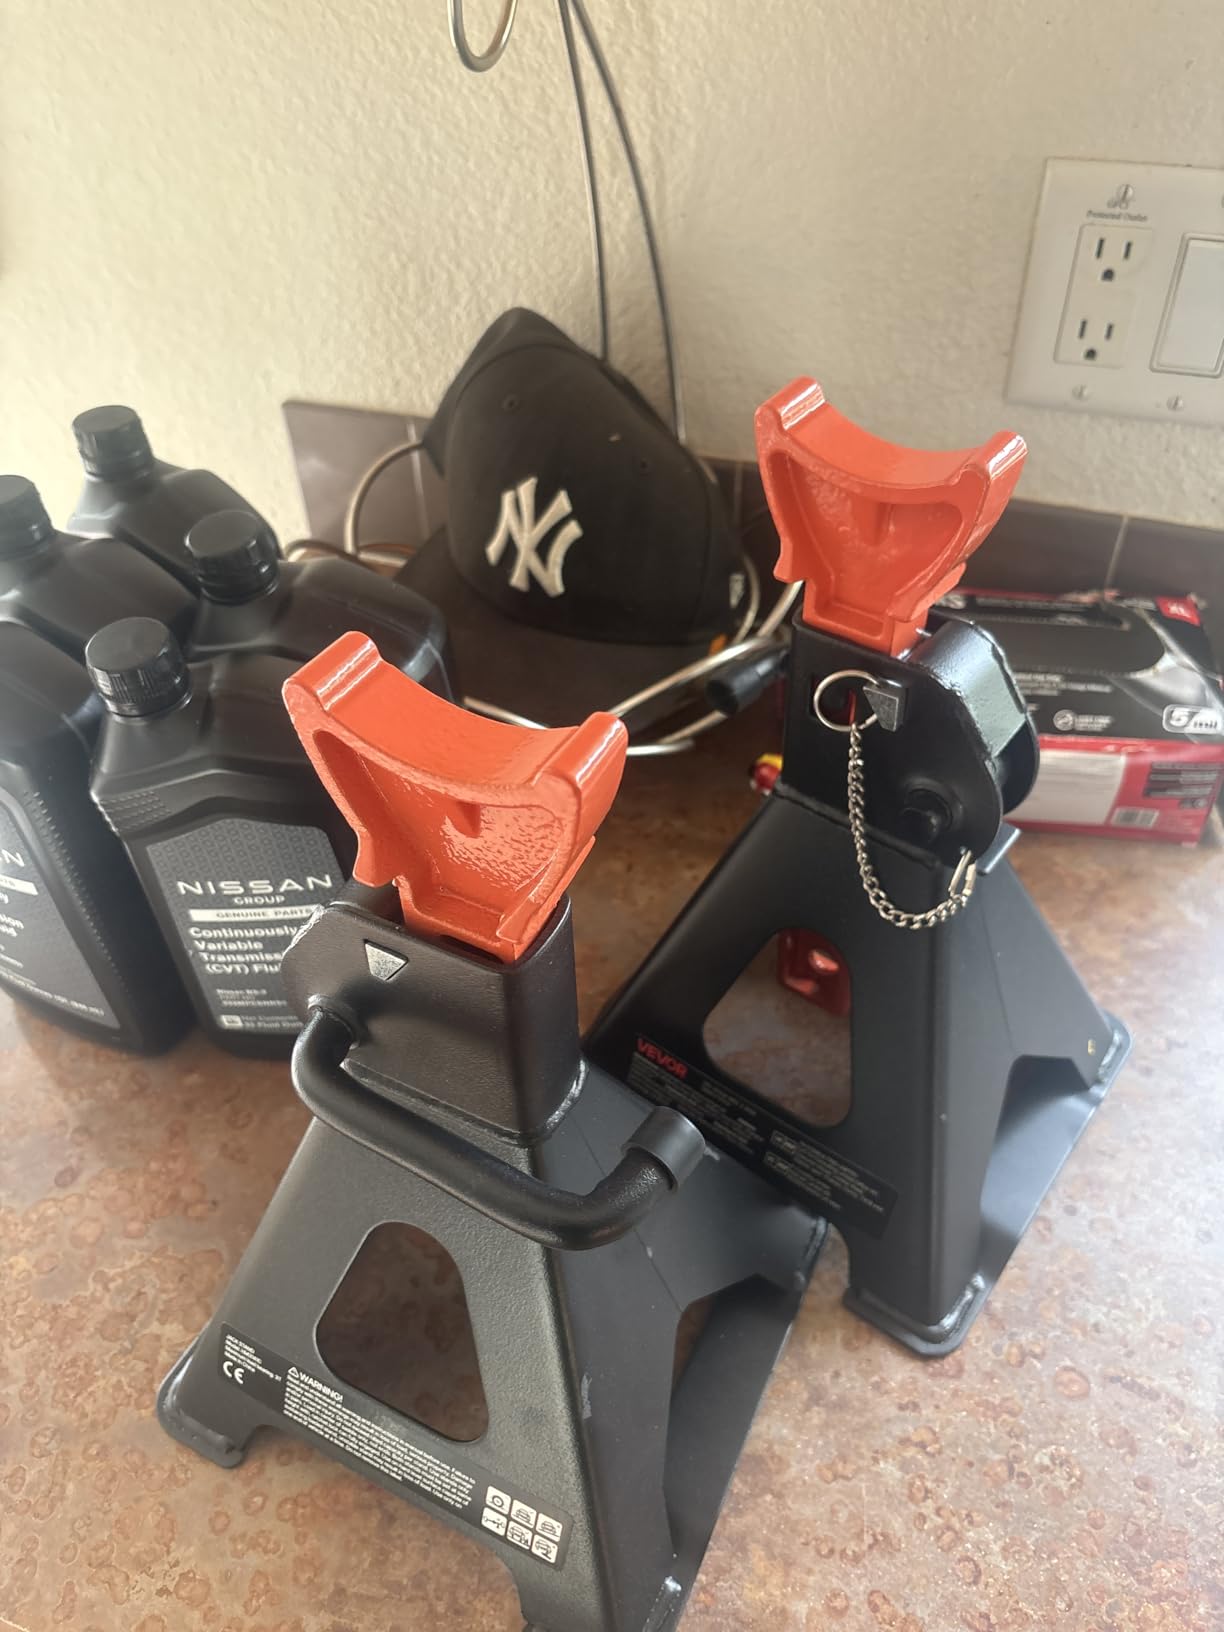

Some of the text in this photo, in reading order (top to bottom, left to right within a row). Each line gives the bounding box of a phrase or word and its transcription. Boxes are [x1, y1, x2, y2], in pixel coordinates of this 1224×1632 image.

[1169, 707, 1190, 727] 5
[176, 873, 333, 896] NISSAN
[233, 895, 286, 905] GROUP
[215, 907, 312, 919] GENUINE PARTS
[189, 924, 298, 939] Continuously
[193, 939, 264, 951] Variable
[200, 951, 283, 963] Transmiss
[205, 962, 281, 976] (CVT) Flu
[637, 1037, 689, 1080] VEVOR
[299, 1371, 344, 1402] WARNING!
